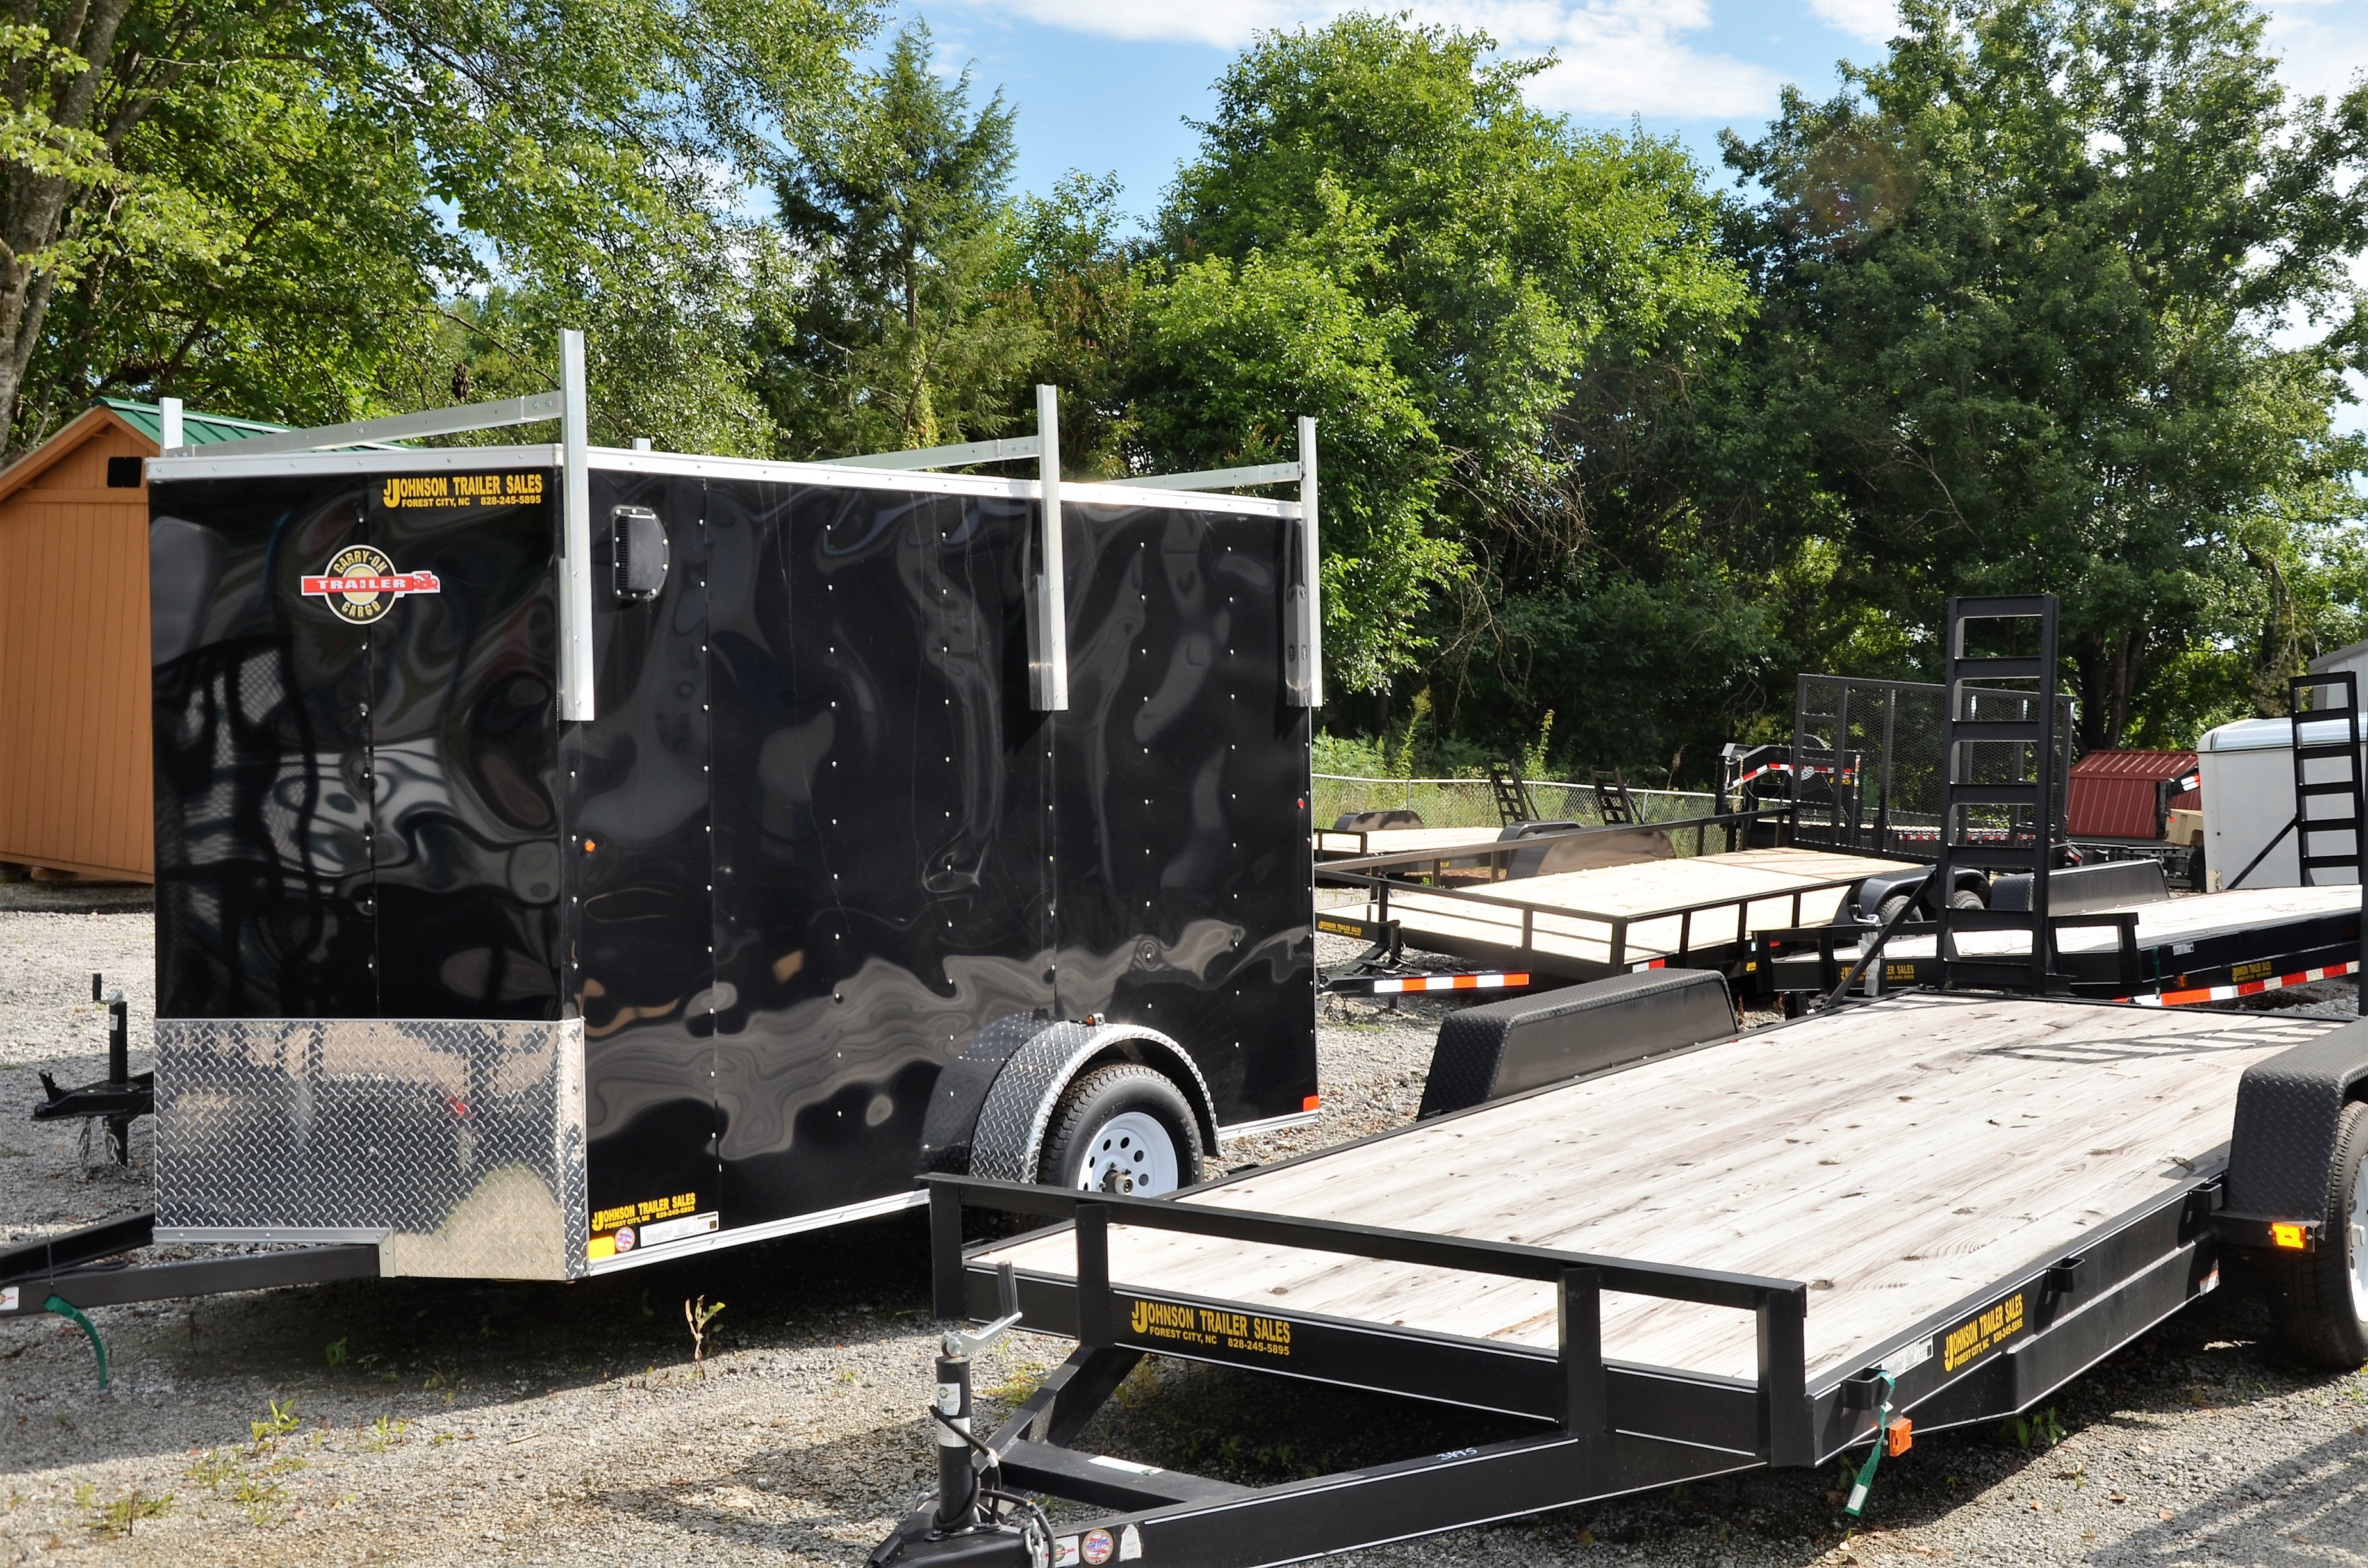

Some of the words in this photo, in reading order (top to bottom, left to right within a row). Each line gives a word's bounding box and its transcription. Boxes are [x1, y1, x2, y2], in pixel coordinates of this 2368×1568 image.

[383, 477, 447, 508] JOHNSON
[453, 476, 501, 496] TRAILER
[506, 474, 543, 494] SALES
[402, 498, 434, 507] FOREST
[436, 498, 456, 507] CITY,
[458, 498, 470, 506] NC
[481, 495, 541, 505] 828-245-5895
[333, 550, 388, 574] CARRY-ON
[317, 578, 406, 590] TRAILER
[341, 601, 381, 617] CARGO
[1897, 965, 1914, 974] SALES
[592, 1204, 634, 1231] JOHNSON
[637, 1197, 669, 1216] TRAILER
[672, 1192, 696, 1208] SALES
[604, 1220, 626, 1229] FOREST
[627, 1216, 641, 1226] CITY,
[1131, 1301, 1194, 1334] JOHNSON
[1199, 1310, 1248, 1337] TRAILER
[1254, 1318, 1290, 1344] SALES
[1944, 1319, 1978, 1372] JOHNSON
[1979, 1305, 2004, 1339] TRAILER
[2005, 1293, 2023, 1321] SALES
[1149, 1327, 1182, 1339] FOREST
[1183, 1331, 1203, 1344] CITY,
[1205, 1334, 1217, 1344] NC
[1228, 1337, 1290, 1355] 828-245-5895
[1954, 1350, 1971, 1368] FOREST
[1971, 1344, 1983, 1358] CITY,
[1983, 1341, 1989, 1350] NC
[1993, 1317, 2023, 1344] 828-245-5895
